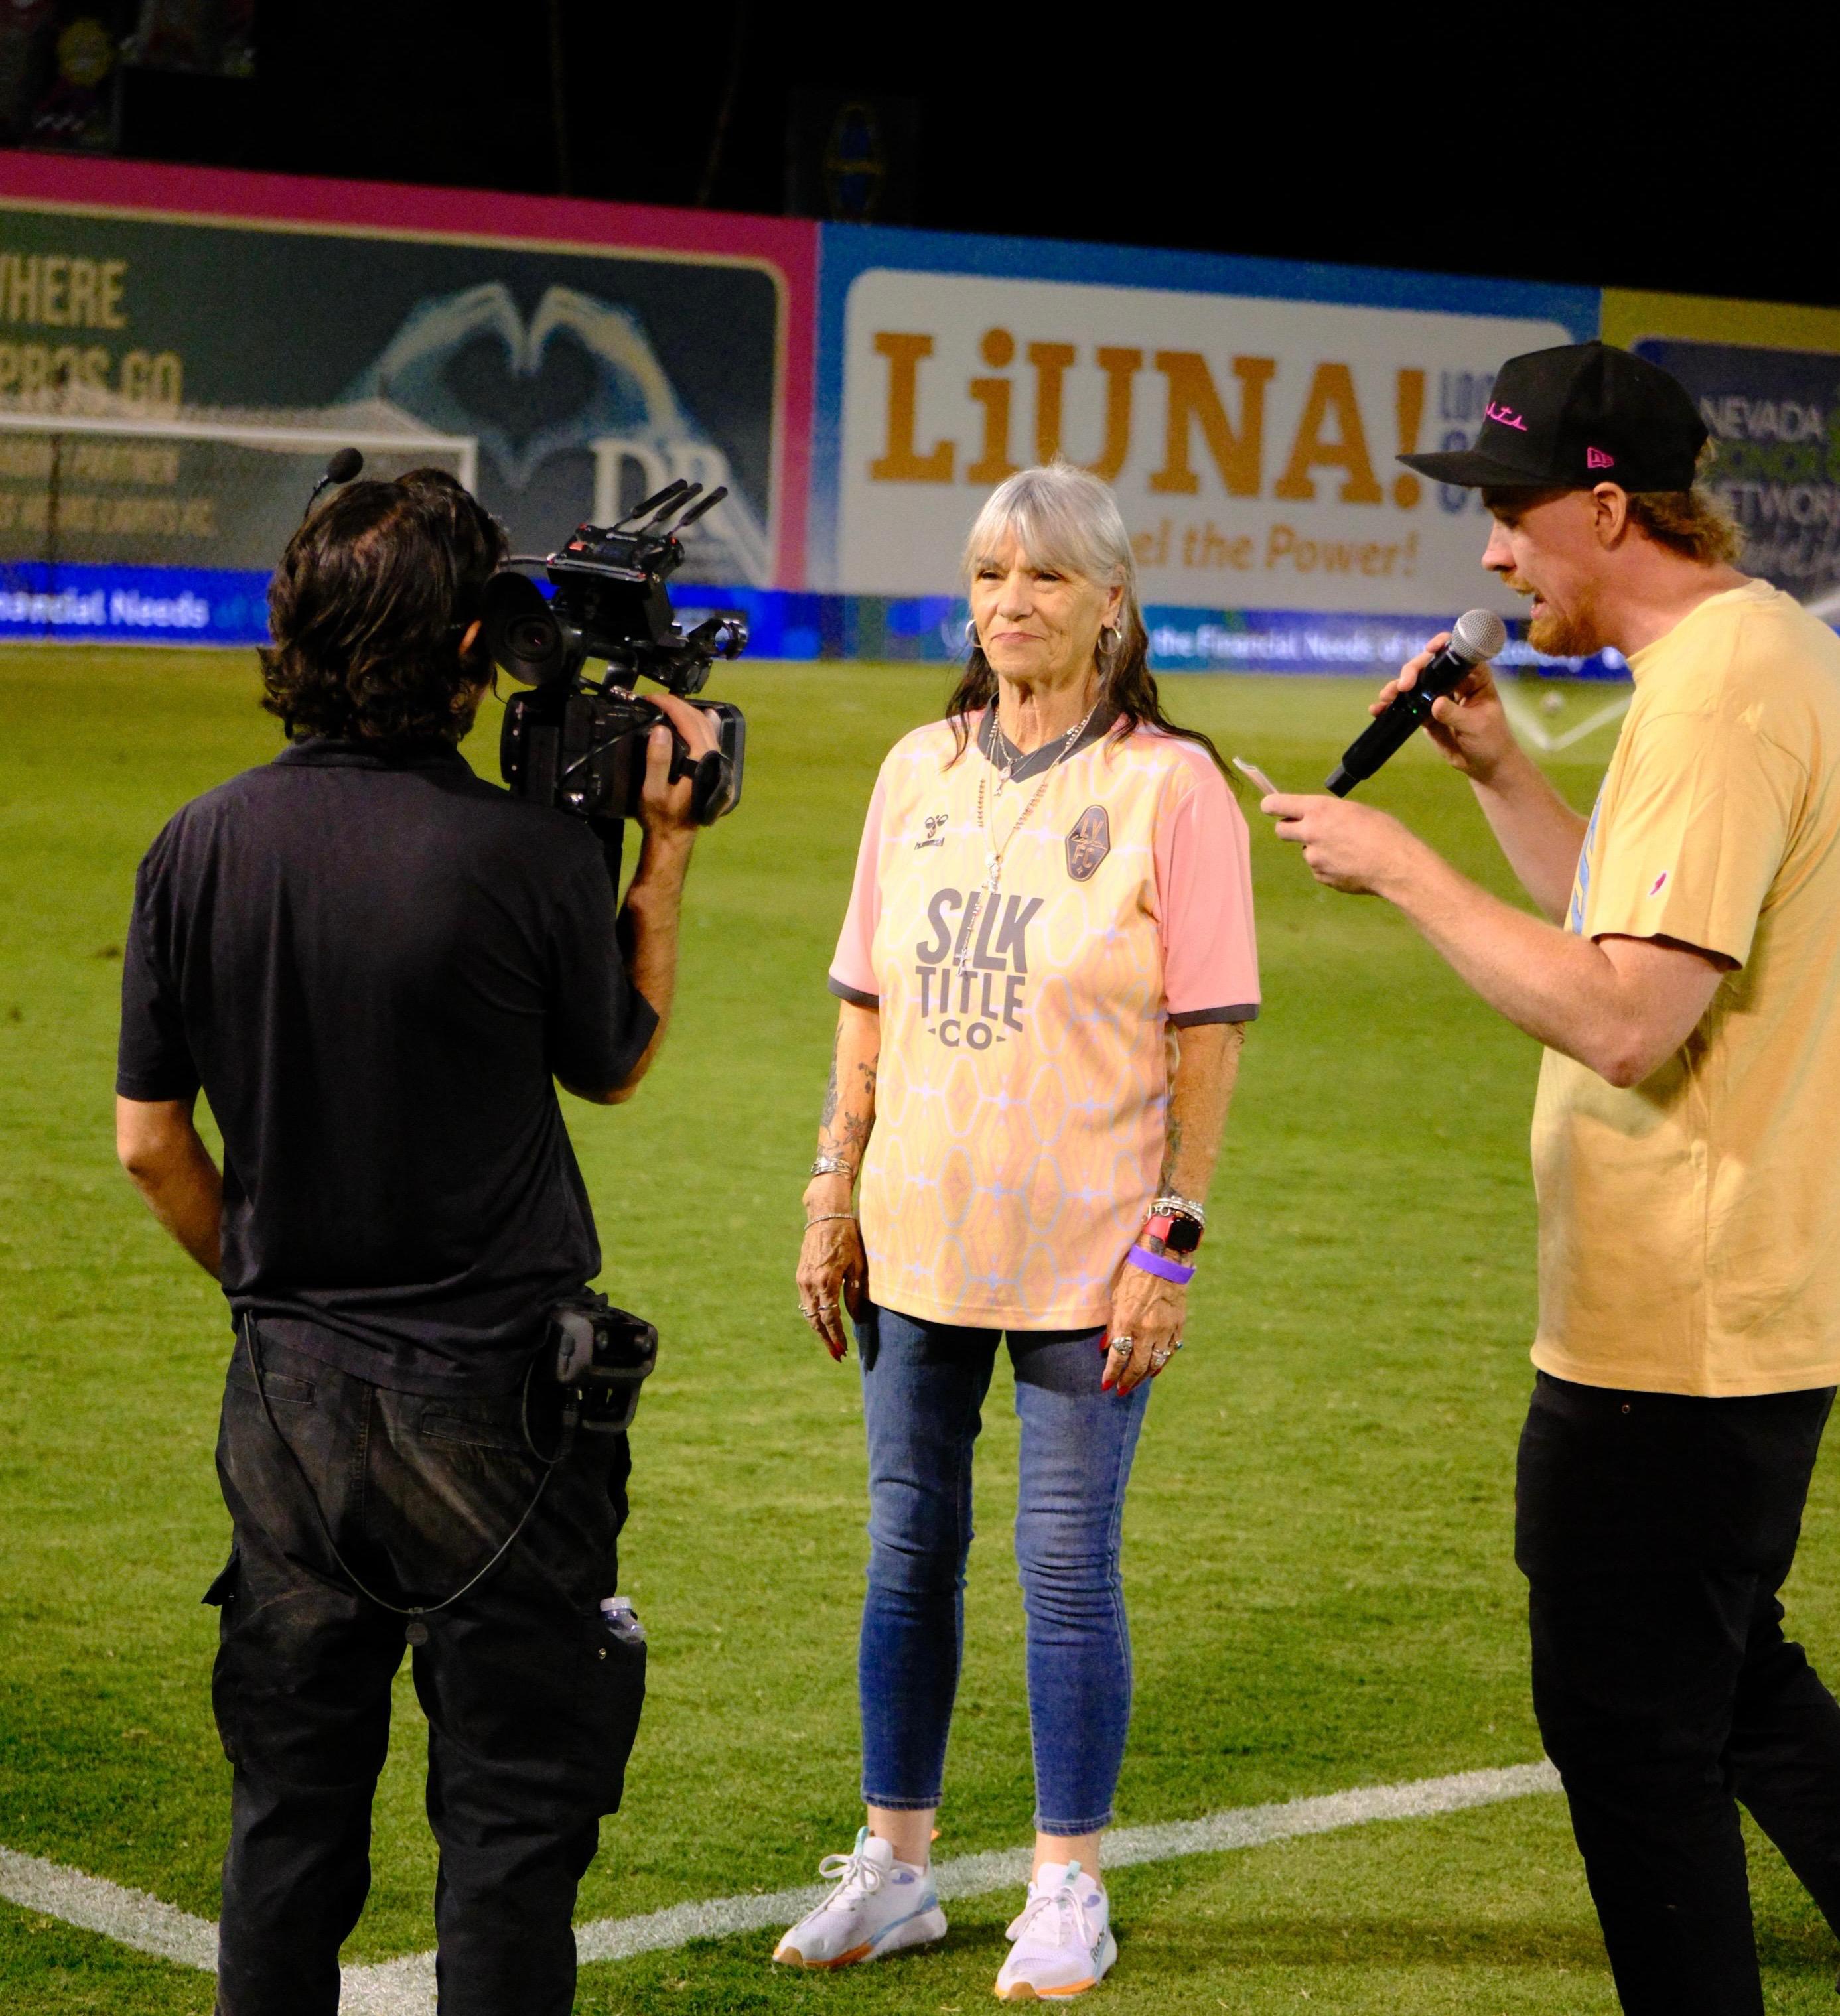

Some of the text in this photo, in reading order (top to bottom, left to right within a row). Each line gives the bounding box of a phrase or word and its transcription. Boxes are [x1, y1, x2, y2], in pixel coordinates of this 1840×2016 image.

[871, 328, 1425, 509] LiUNA!
[1699, 396, 1825, 443] NEVADA
[1715, 480, 1840, 531] ETWOR
[1131, 519, 1419, 577] el the Power!
[109, 588, 210, 629] Needs
[1153, 626, 1193, 657] the
[1196, 624, 1299, 661] Financial
[1305, 628, 1372, 662] Needs
[1080, 817, 1104, 840] LV
[1072, 844, 1094, 868] FC
[916, 888, 1044, 973] SILK
[915, 965, 1026, 1033] TITLE
[939, 1018, 993, 1051] CO
